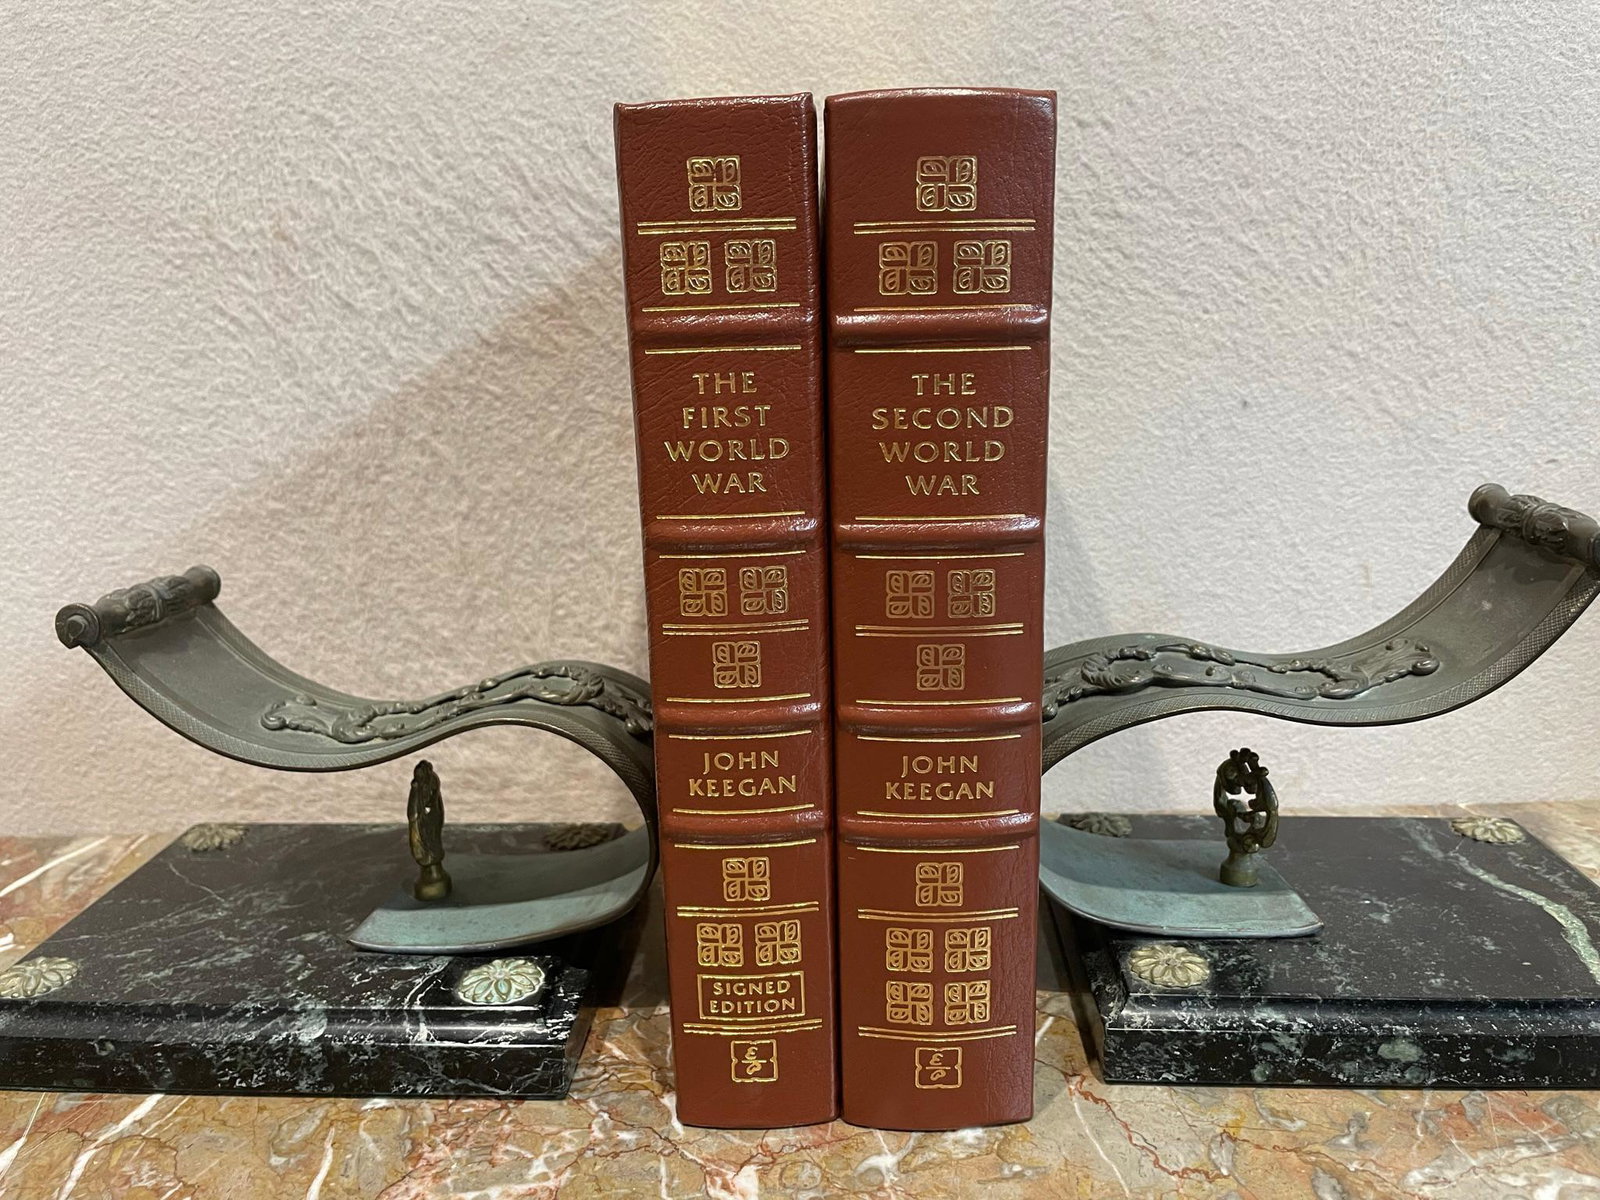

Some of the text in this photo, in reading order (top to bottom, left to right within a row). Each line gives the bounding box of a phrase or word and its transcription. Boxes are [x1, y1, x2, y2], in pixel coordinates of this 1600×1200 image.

[691, 371, 758, 395] THE
[911, 372, 977, 396] THE
[682, 404, 771, 429] FIRST
[871, 405, 1014, 430] SECOND
[663, 437, 790, 462] WORLD
[878, 440, 1006, 464] WORLD
[691, 471, 768, 495] WAR
[904, 474, 980, 496] WAR
[702, 751, 780, 774] JOHN
[901, 755, 978, 777] JOHN
[688, 774, 797, 798] KEEGAN
[885, 780, 995, 801] KEEGAN
[713, 980, 791, 996] SIGNED
[709, 998, 796, 1014] EDITION
